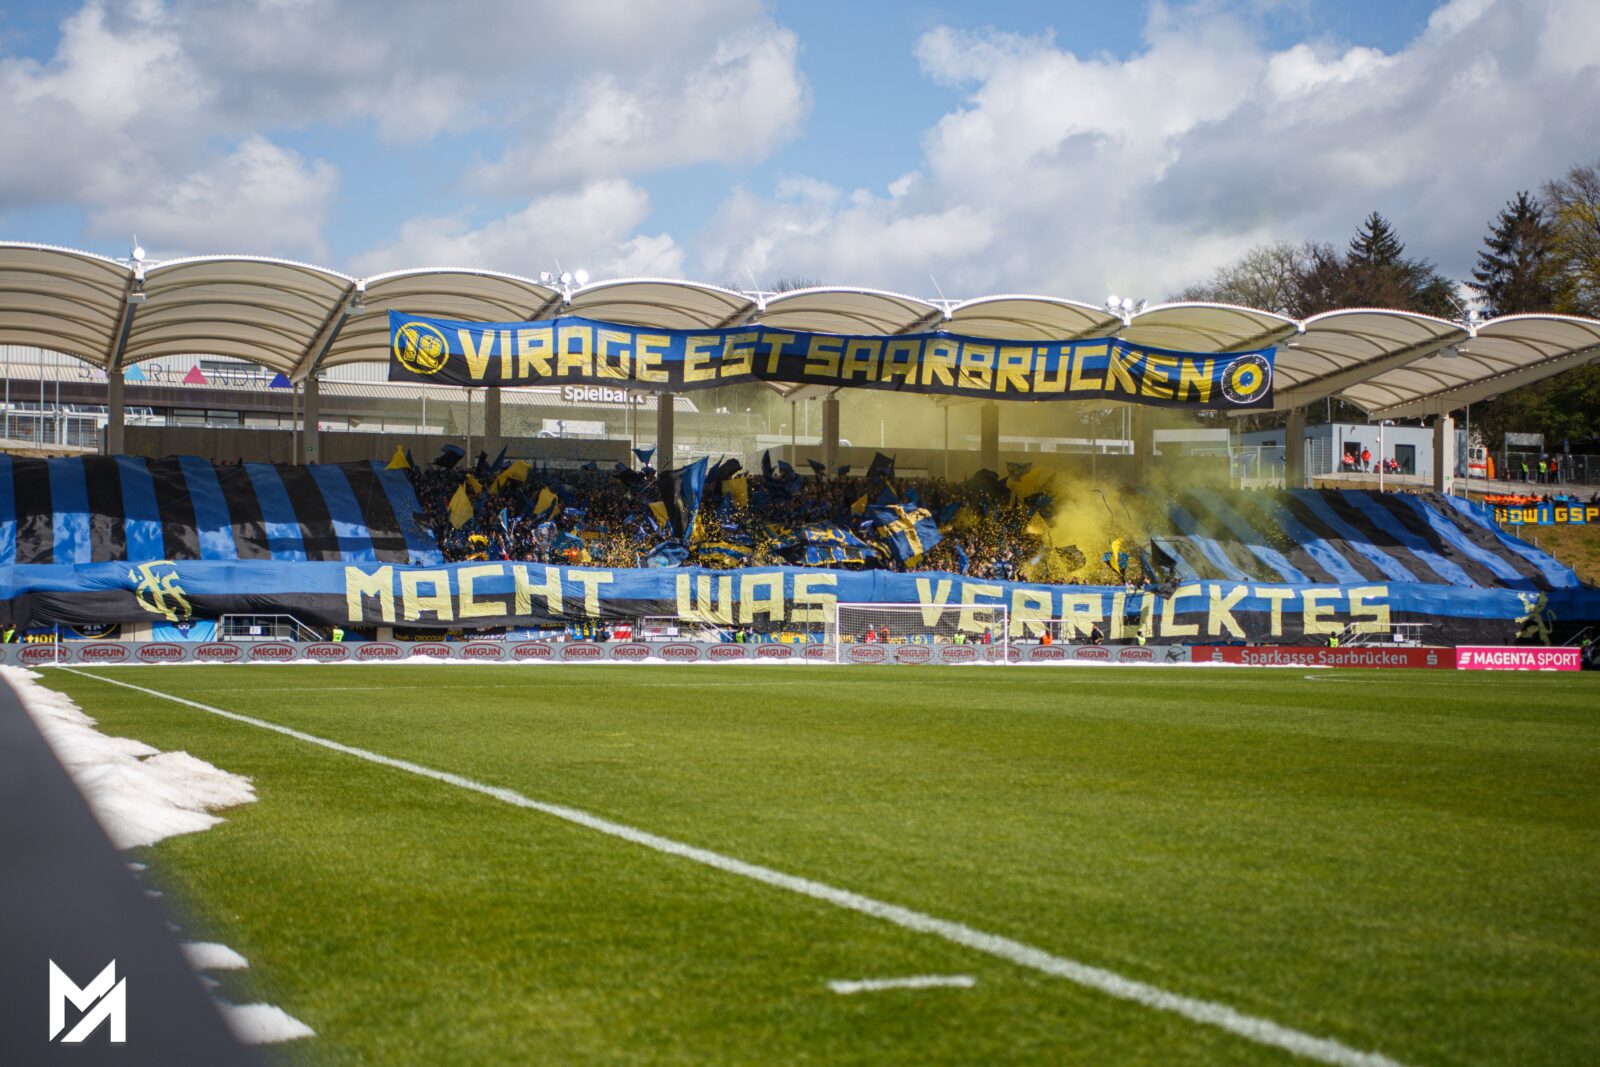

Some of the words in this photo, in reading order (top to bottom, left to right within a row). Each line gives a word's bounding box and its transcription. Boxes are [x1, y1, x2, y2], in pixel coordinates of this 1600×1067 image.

[457, 326, 671, 383] VIRAGE
[683, 332, 796, 383] EST
[803, 336, 1215, 403] SAARBRÜCKEN
[345, 565, 614, 622] MACHT
[676, 572, 837, 625] WAS
[1241, 651, 1315, 666] Sparkasse
[1319, 651, 1408, 666] Saarbrücken
[1473, 652, 1535, 665] MAGENTA
[1537, 653, 1578, 666] SPORT
